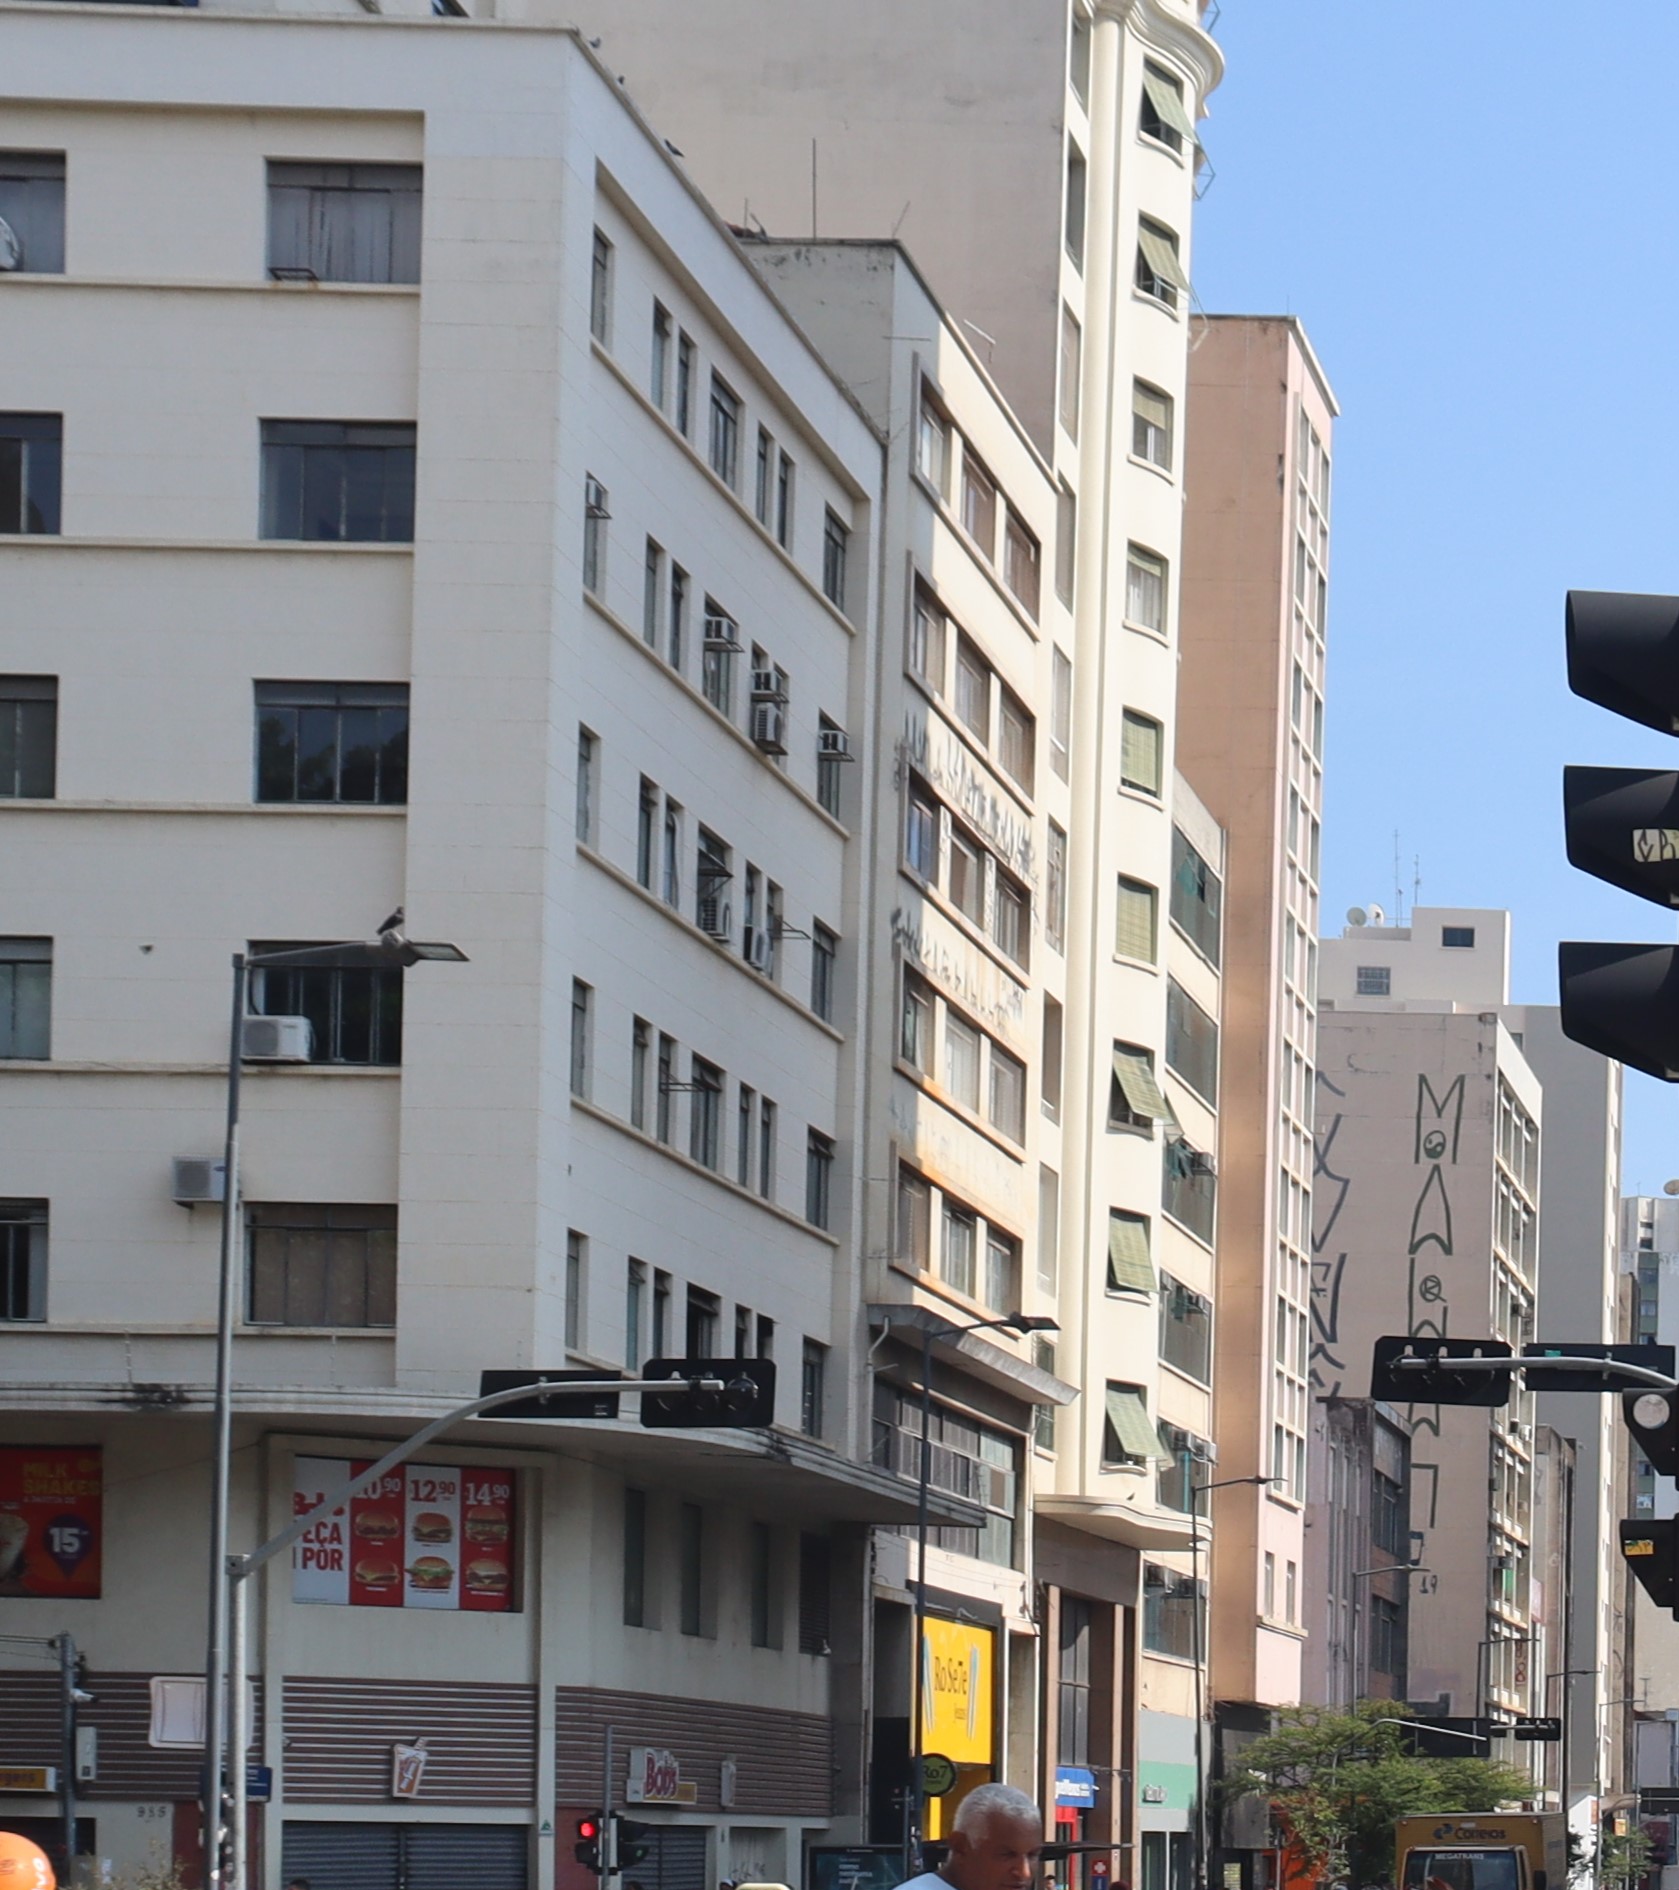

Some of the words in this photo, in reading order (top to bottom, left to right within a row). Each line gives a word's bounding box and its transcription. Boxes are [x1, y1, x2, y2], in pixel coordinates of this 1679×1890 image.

[49, 1527, 81, 1554] 15
[300, 1521, 343, 1549] EÇA
[302, 1546, 343, 1572] POR
